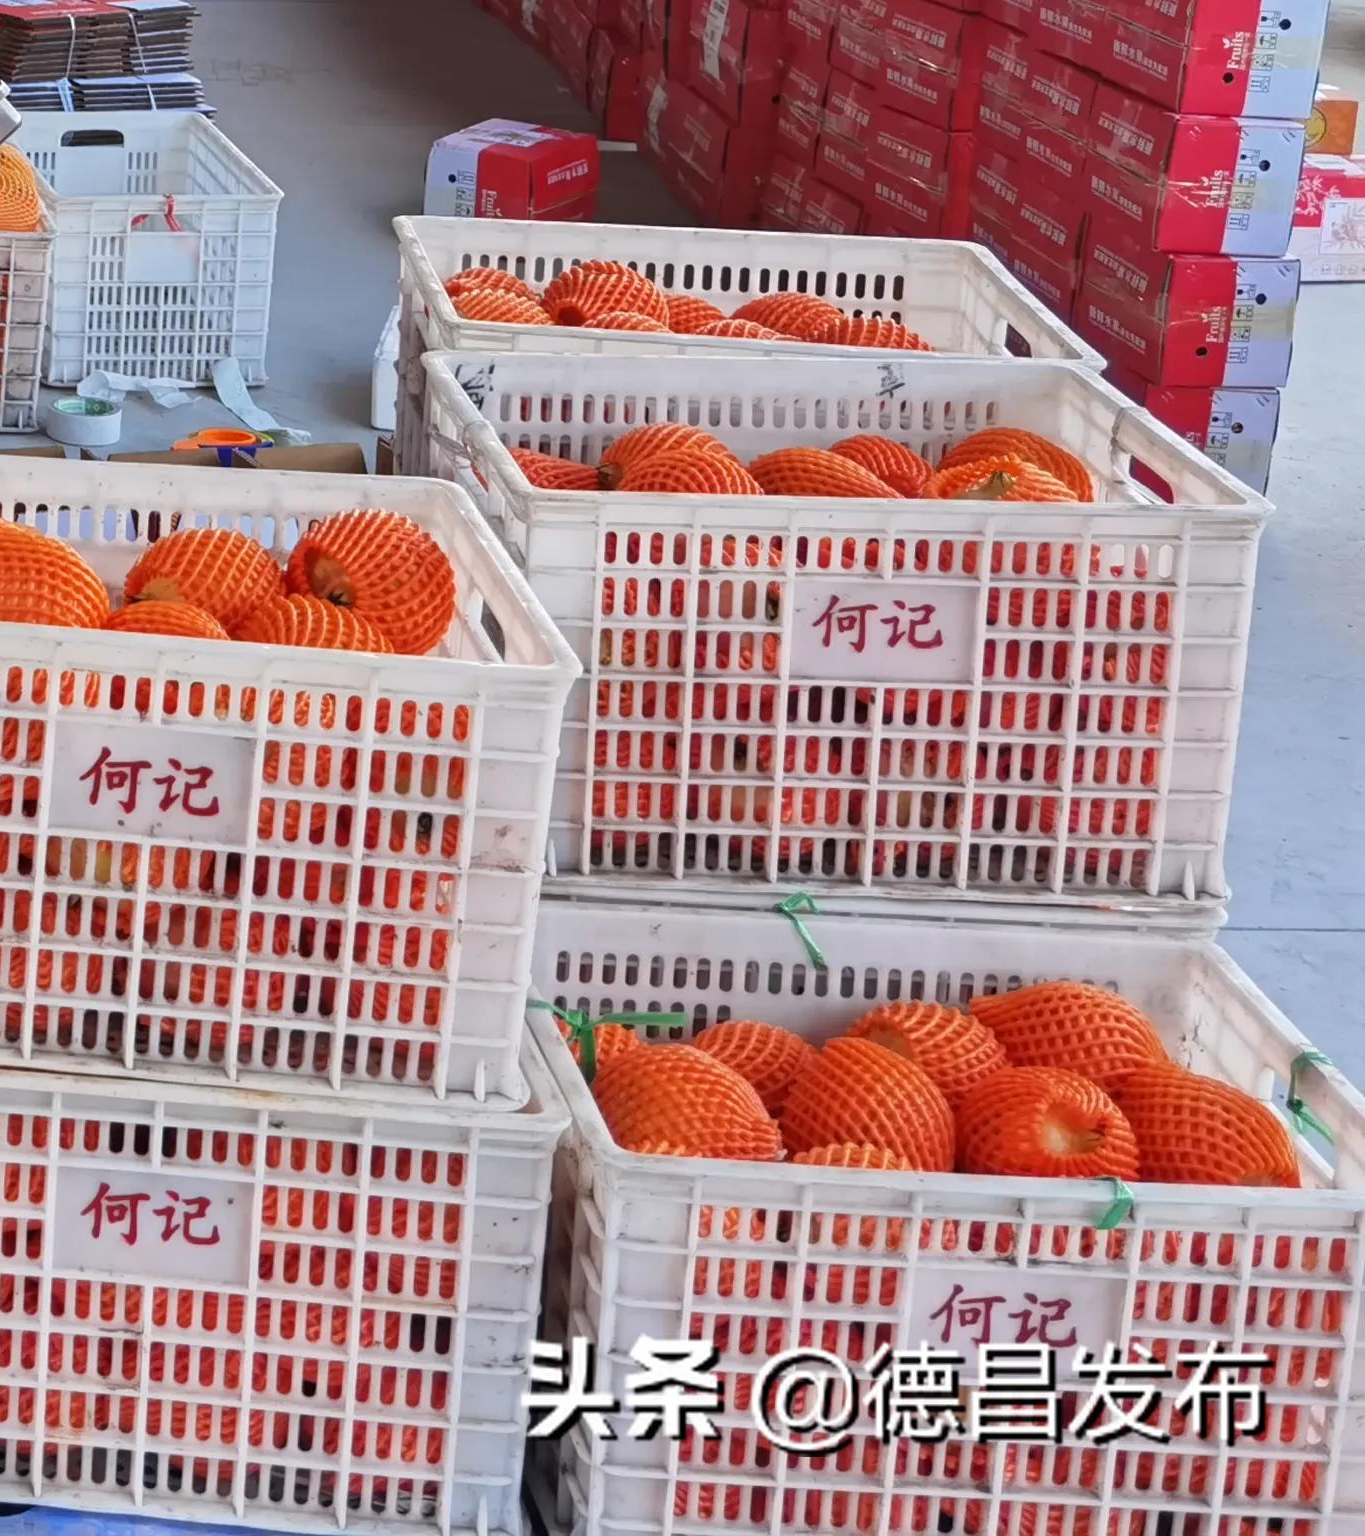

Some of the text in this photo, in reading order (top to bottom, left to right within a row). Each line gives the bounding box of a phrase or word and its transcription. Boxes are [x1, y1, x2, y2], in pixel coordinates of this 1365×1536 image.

[1226, 31, 1245, 70] Fruits
[1206, 305, 1222, 343] Fruits
[812, 593, 944, 654] 何记
[79, 745, 220, 818] 何记
[80, 1181, 221, 1247] 何记
[929, 1281, 1079, 1348] 何记
